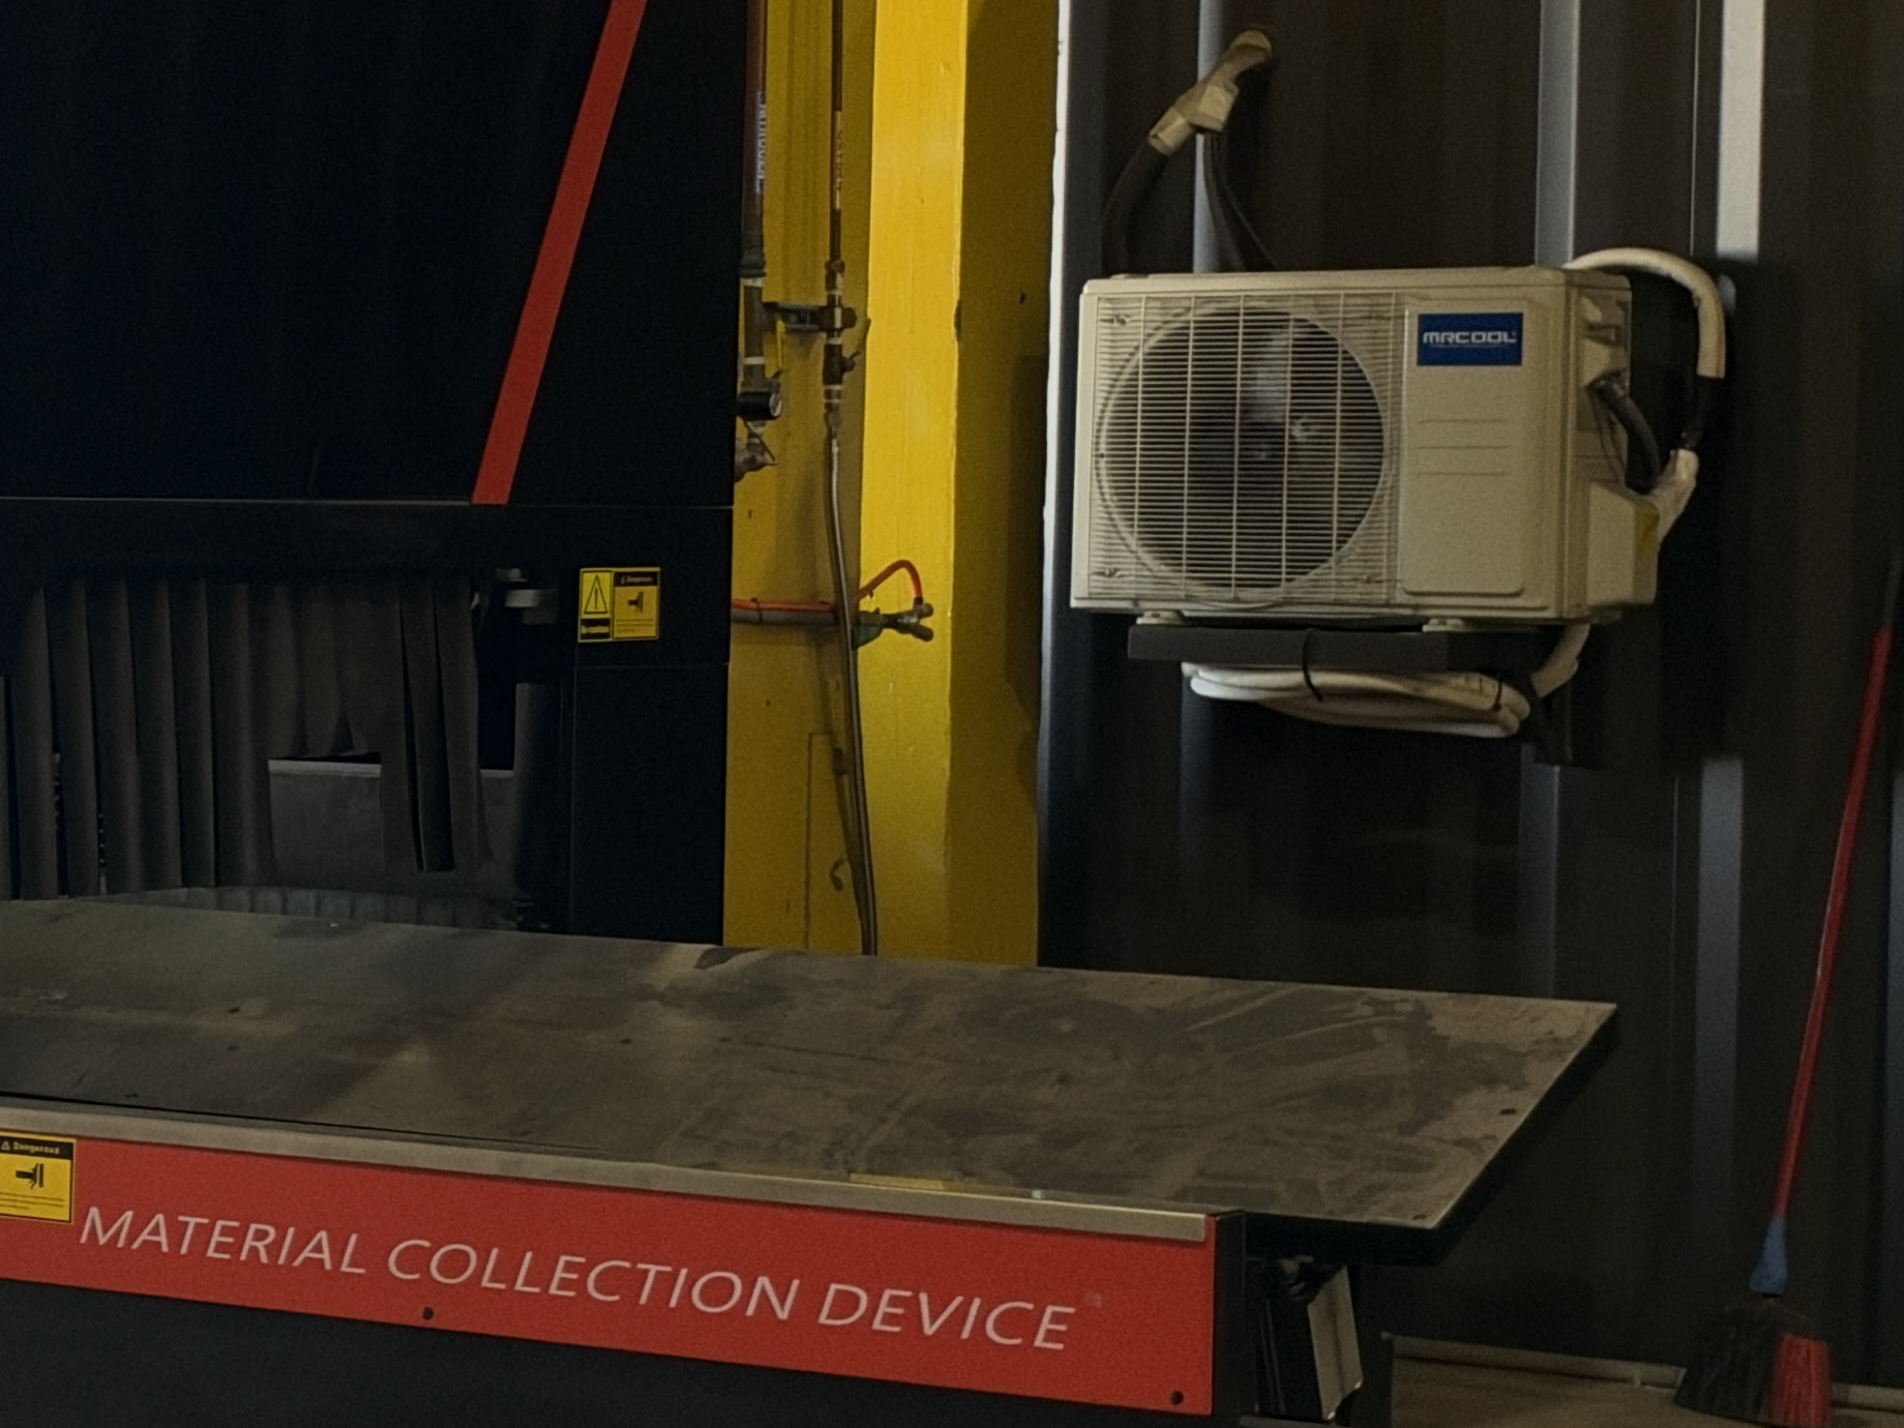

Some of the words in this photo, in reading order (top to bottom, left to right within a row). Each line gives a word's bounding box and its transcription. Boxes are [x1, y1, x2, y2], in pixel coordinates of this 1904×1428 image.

[1422, 331, 1517, 345] MRCOOL
[80, 1206, 366, 1274] MATERIAL
[387, 1239, 800, 1321] COLLECTION
[817, 1283, 1075, 1350] DEVICE
